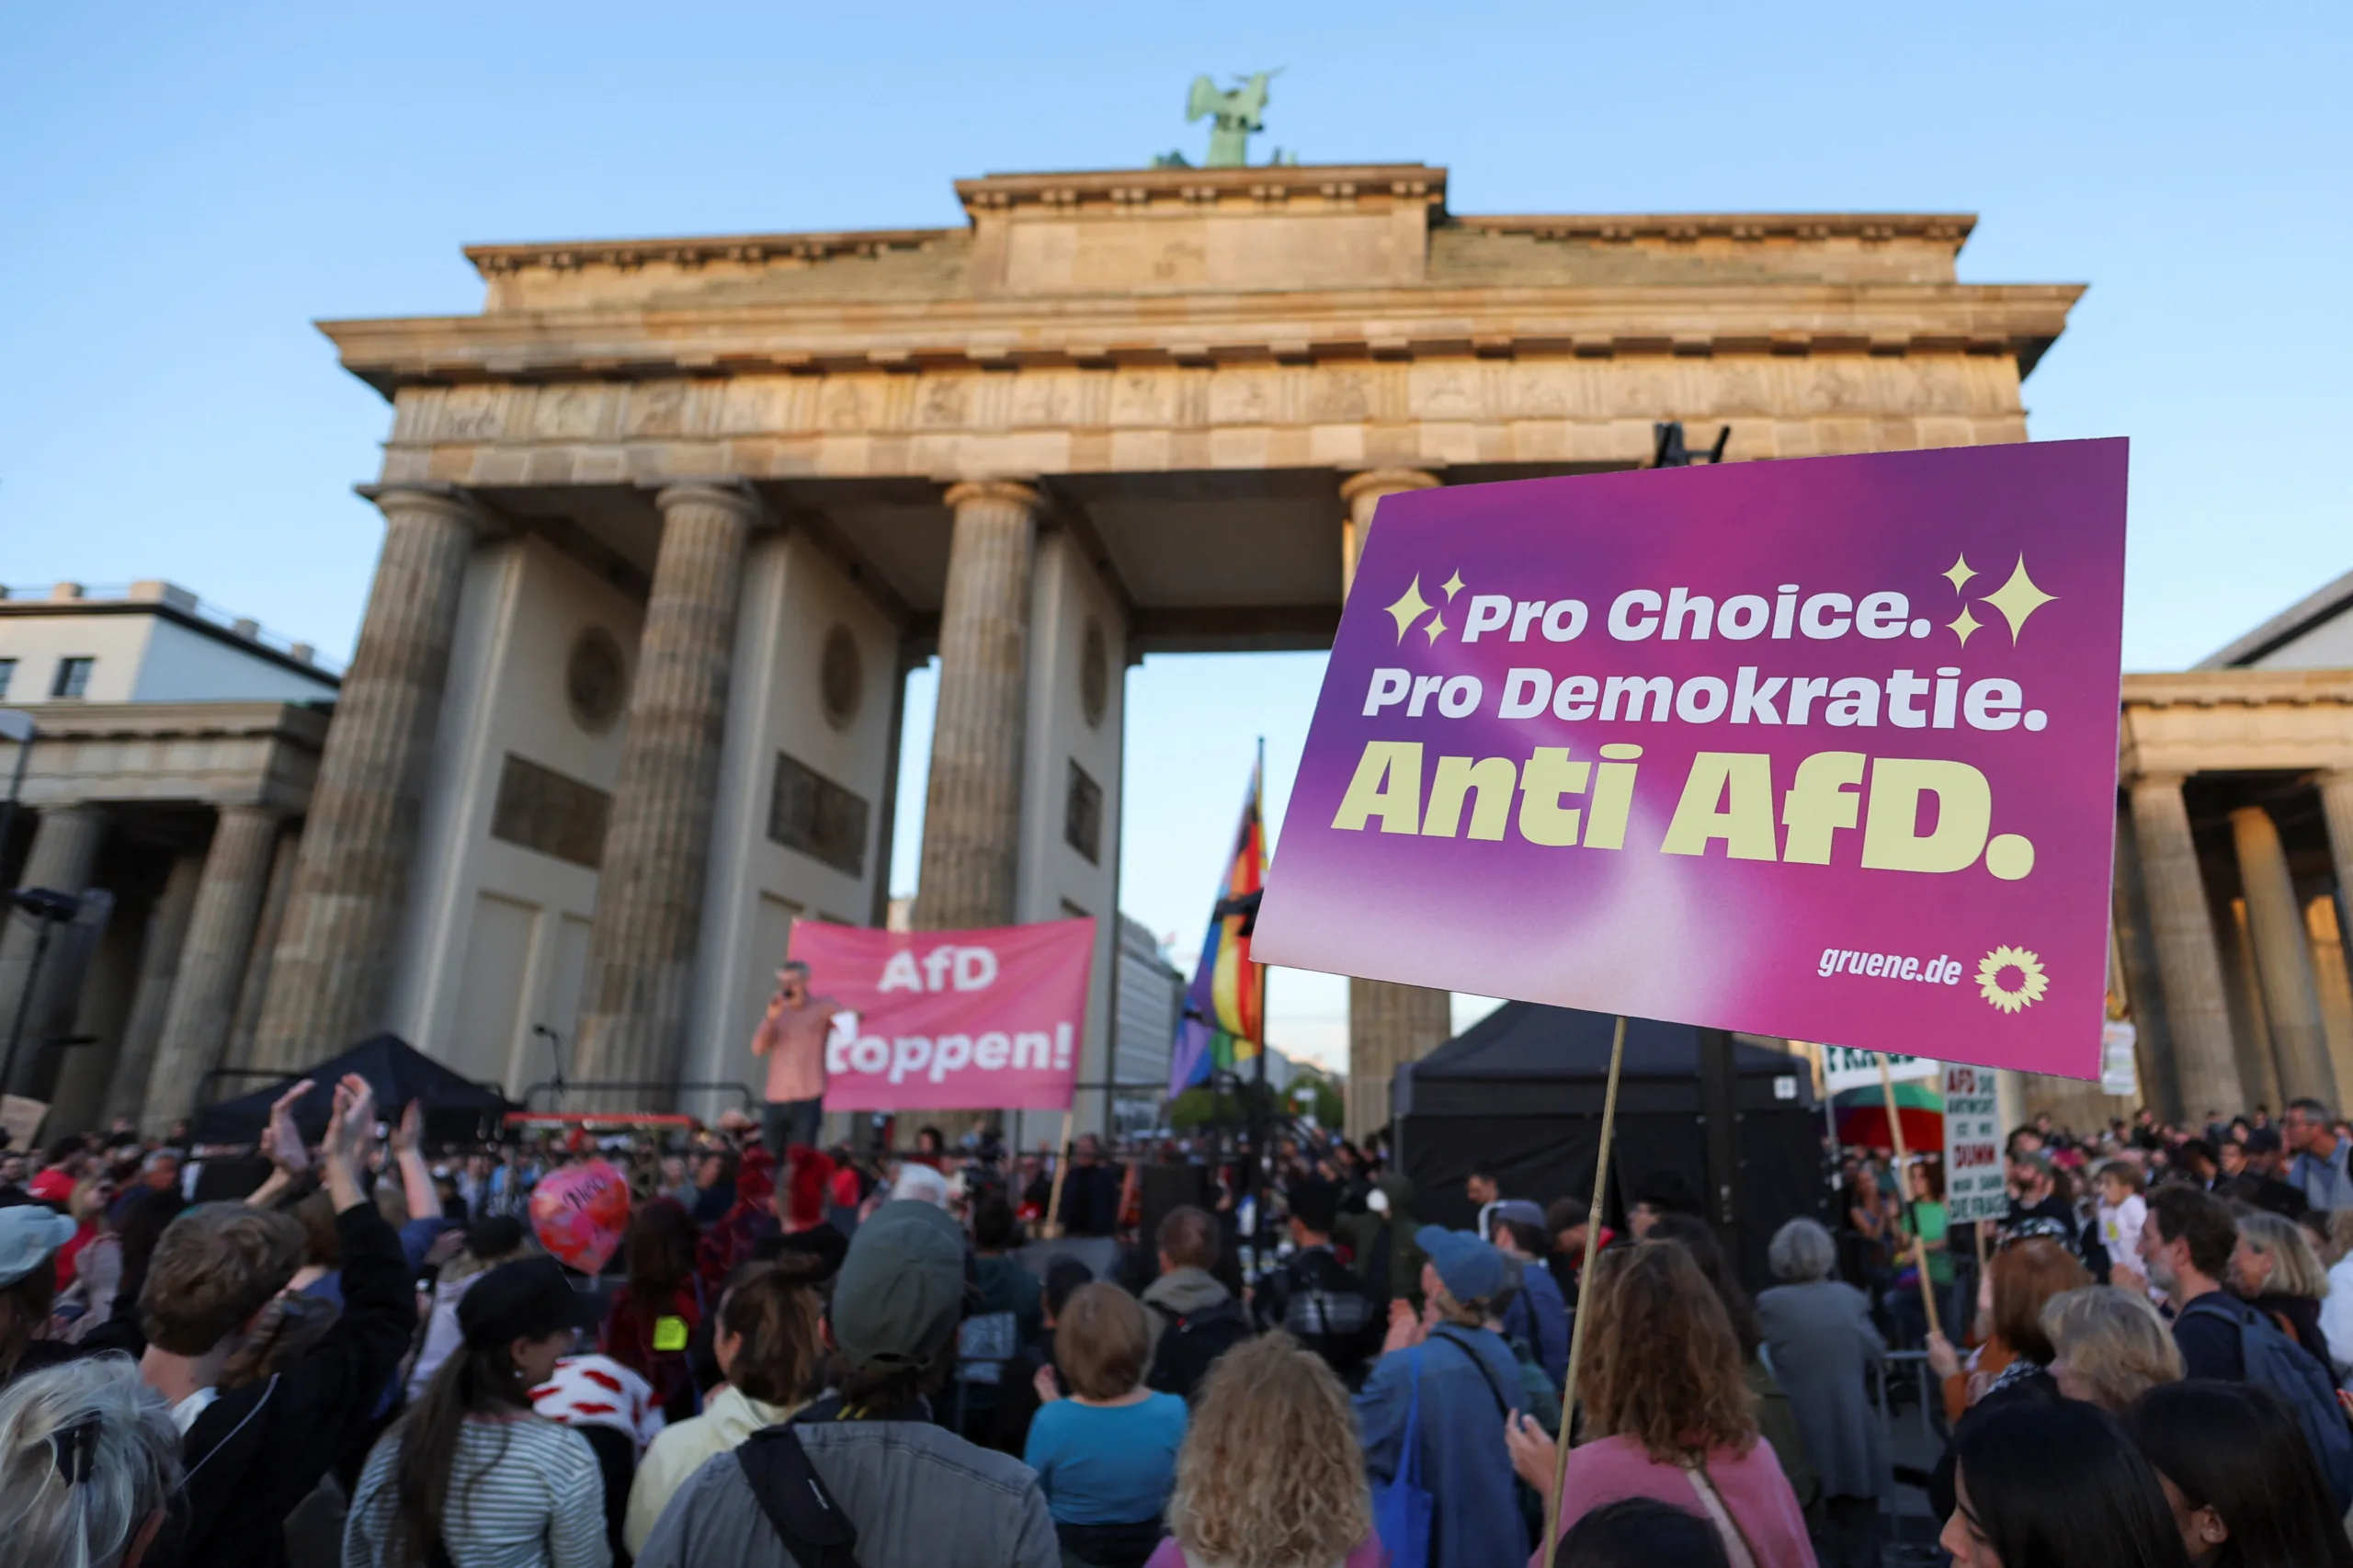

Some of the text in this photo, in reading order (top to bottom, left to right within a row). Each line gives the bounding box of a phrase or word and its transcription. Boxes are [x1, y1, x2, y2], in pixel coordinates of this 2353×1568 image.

[1461, 584, 1931, 642] Pro Choice.
[1361, 666, 2048, 732] Pro Demokratie.
[1331, 741, 2035, 881] Anti AfD.
[877, 945, 999, 993] AfD
[1817, 948, 1962, 985] gruene.de
[825, 1022, 1074, 1084] toppen!
